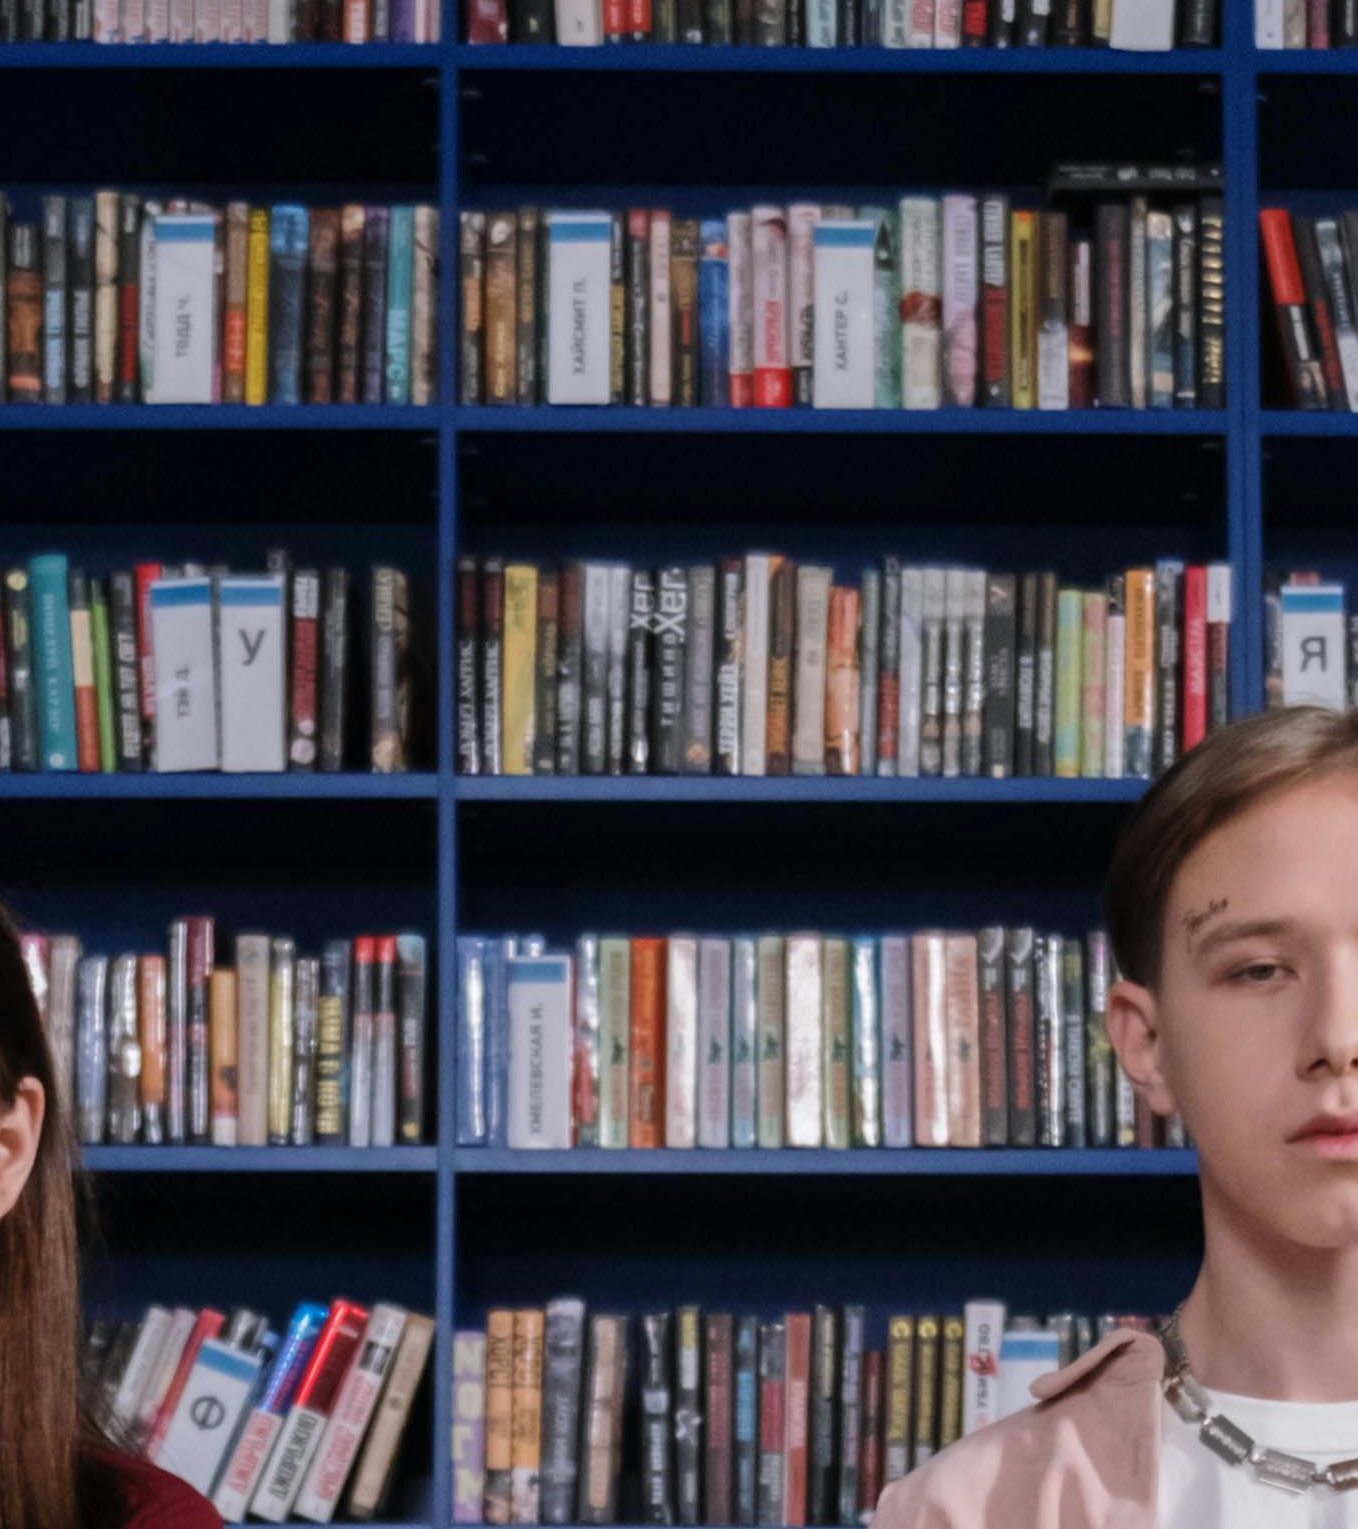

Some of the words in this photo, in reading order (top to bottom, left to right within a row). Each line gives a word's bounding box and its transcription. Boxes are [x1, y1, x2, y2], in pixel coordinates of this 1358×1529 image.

[834, 289, 849, 307] С.
[175, 312, 193, 359] ТОДД
[570, 296, 586, 375] ХАЙСМИТ
[834, 309, 849, 372] ХАНТЕР
[237, 627, 267, 668] У
[1299, 635, 1329, 673] Я
[529, 1023, 545, 1137] ХМЕЛЕВСКАЯ
[190, 1395, 225, 1431] Ф
